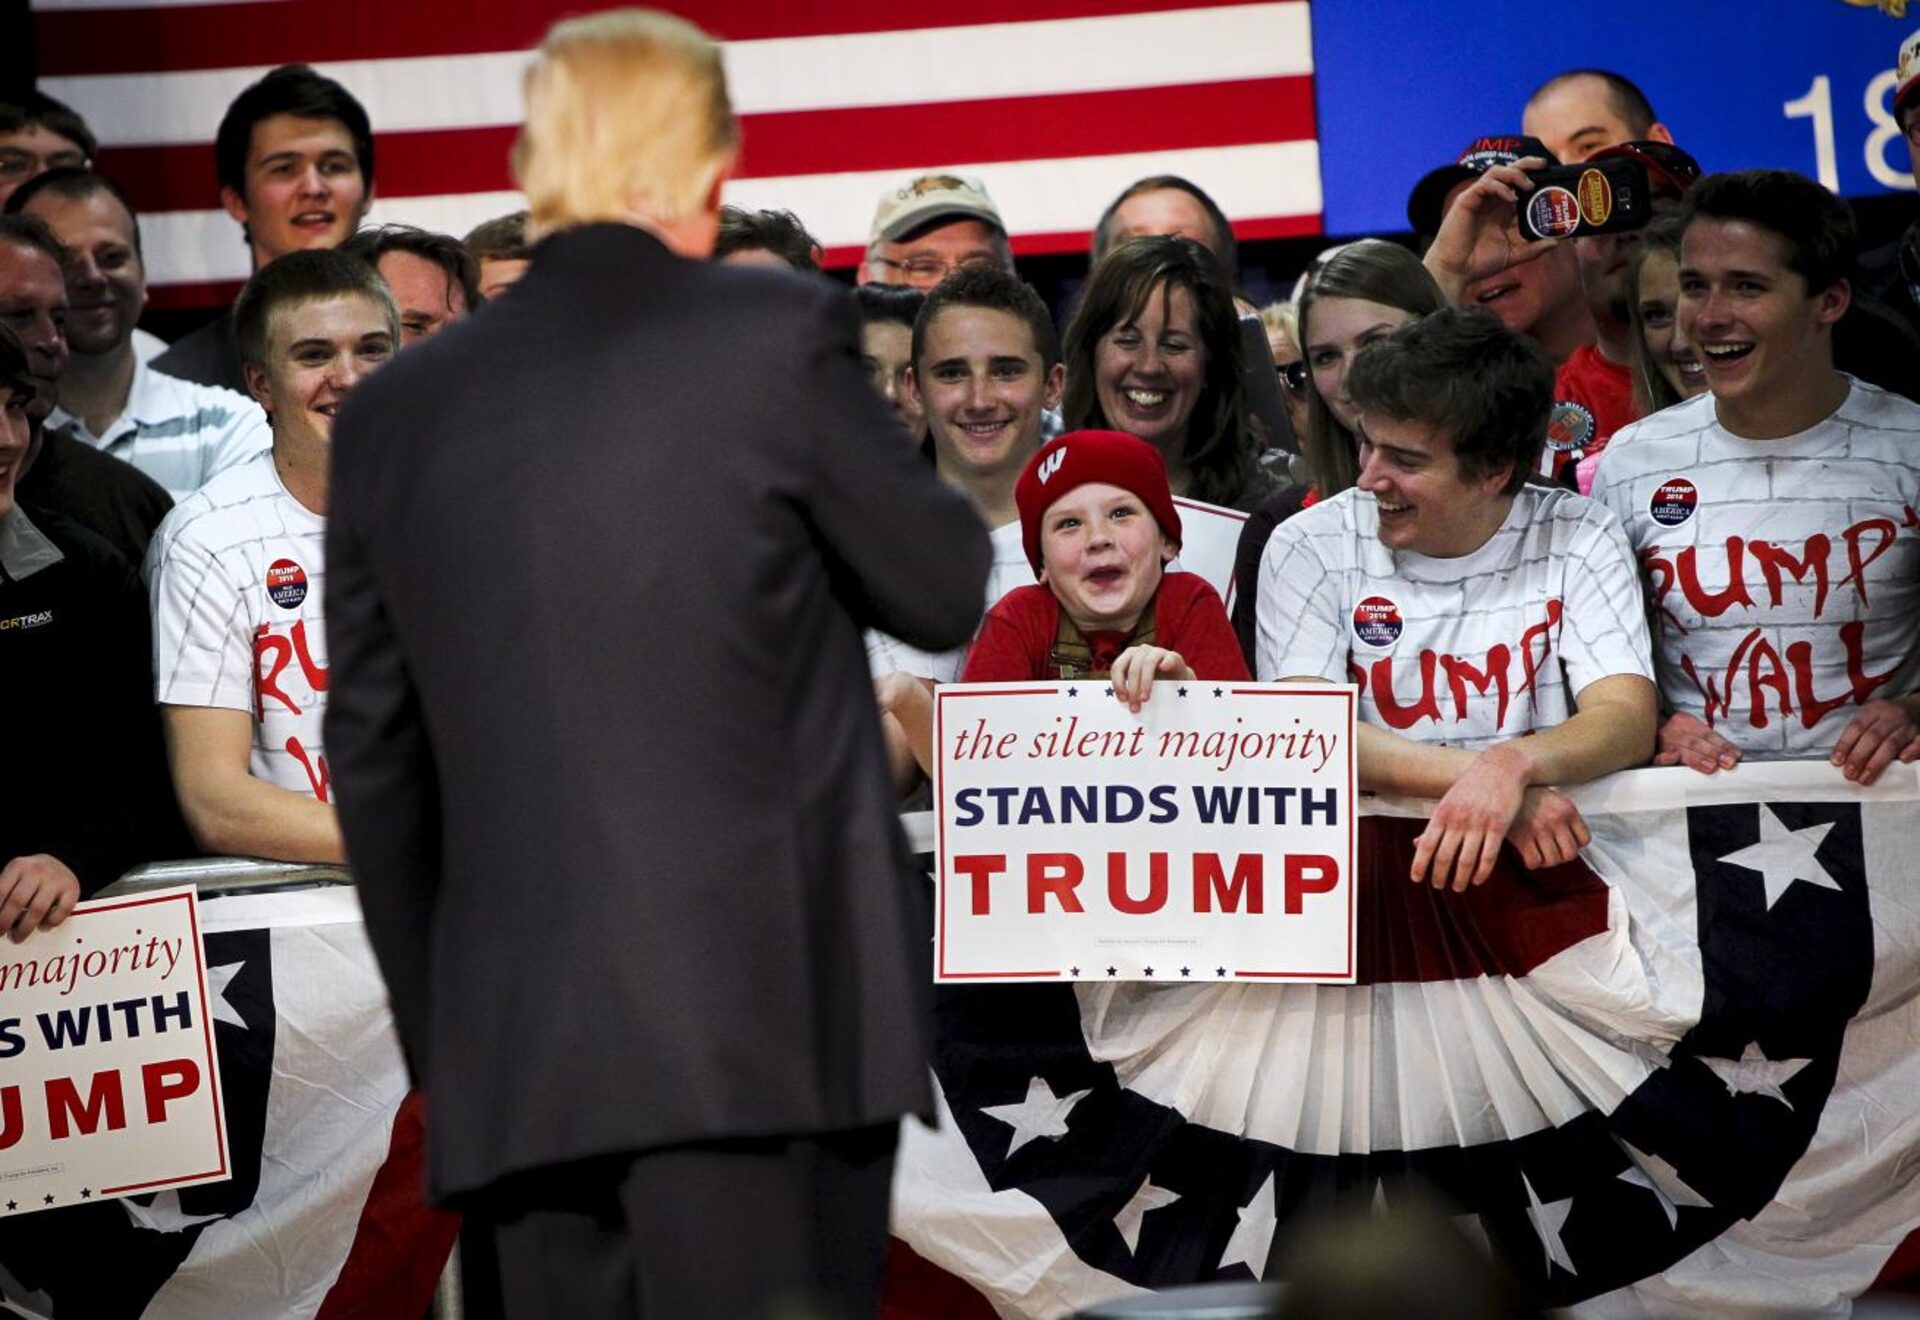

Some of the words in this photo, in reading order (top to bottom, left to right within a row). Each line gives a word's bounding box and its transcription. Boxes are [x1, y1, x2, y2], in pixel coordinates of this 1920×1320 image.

[1037, 446, 1067, 485] W
[1660, 486, 1694, 494] TRUMP
[269, 566, 300, 576] TRUMP
[1359, 604, 1397, 613] TRUMP
[1347, 599, 1563, 733] UMP
[1680, 621, 1902, 730] WALL
[954, 718, 1018, 761] the
[1027, 716, 1145, 759] silent
[1158, 717, 1337, 773] majority
[954, 785, 1179, 826] STANDS
[1192, 785, 1337, 826] WITH
[954, 852, 1339, 915] TRUMP
[0, 928, 183, 996] majority
[36, 990, 193, 1051] WITH
